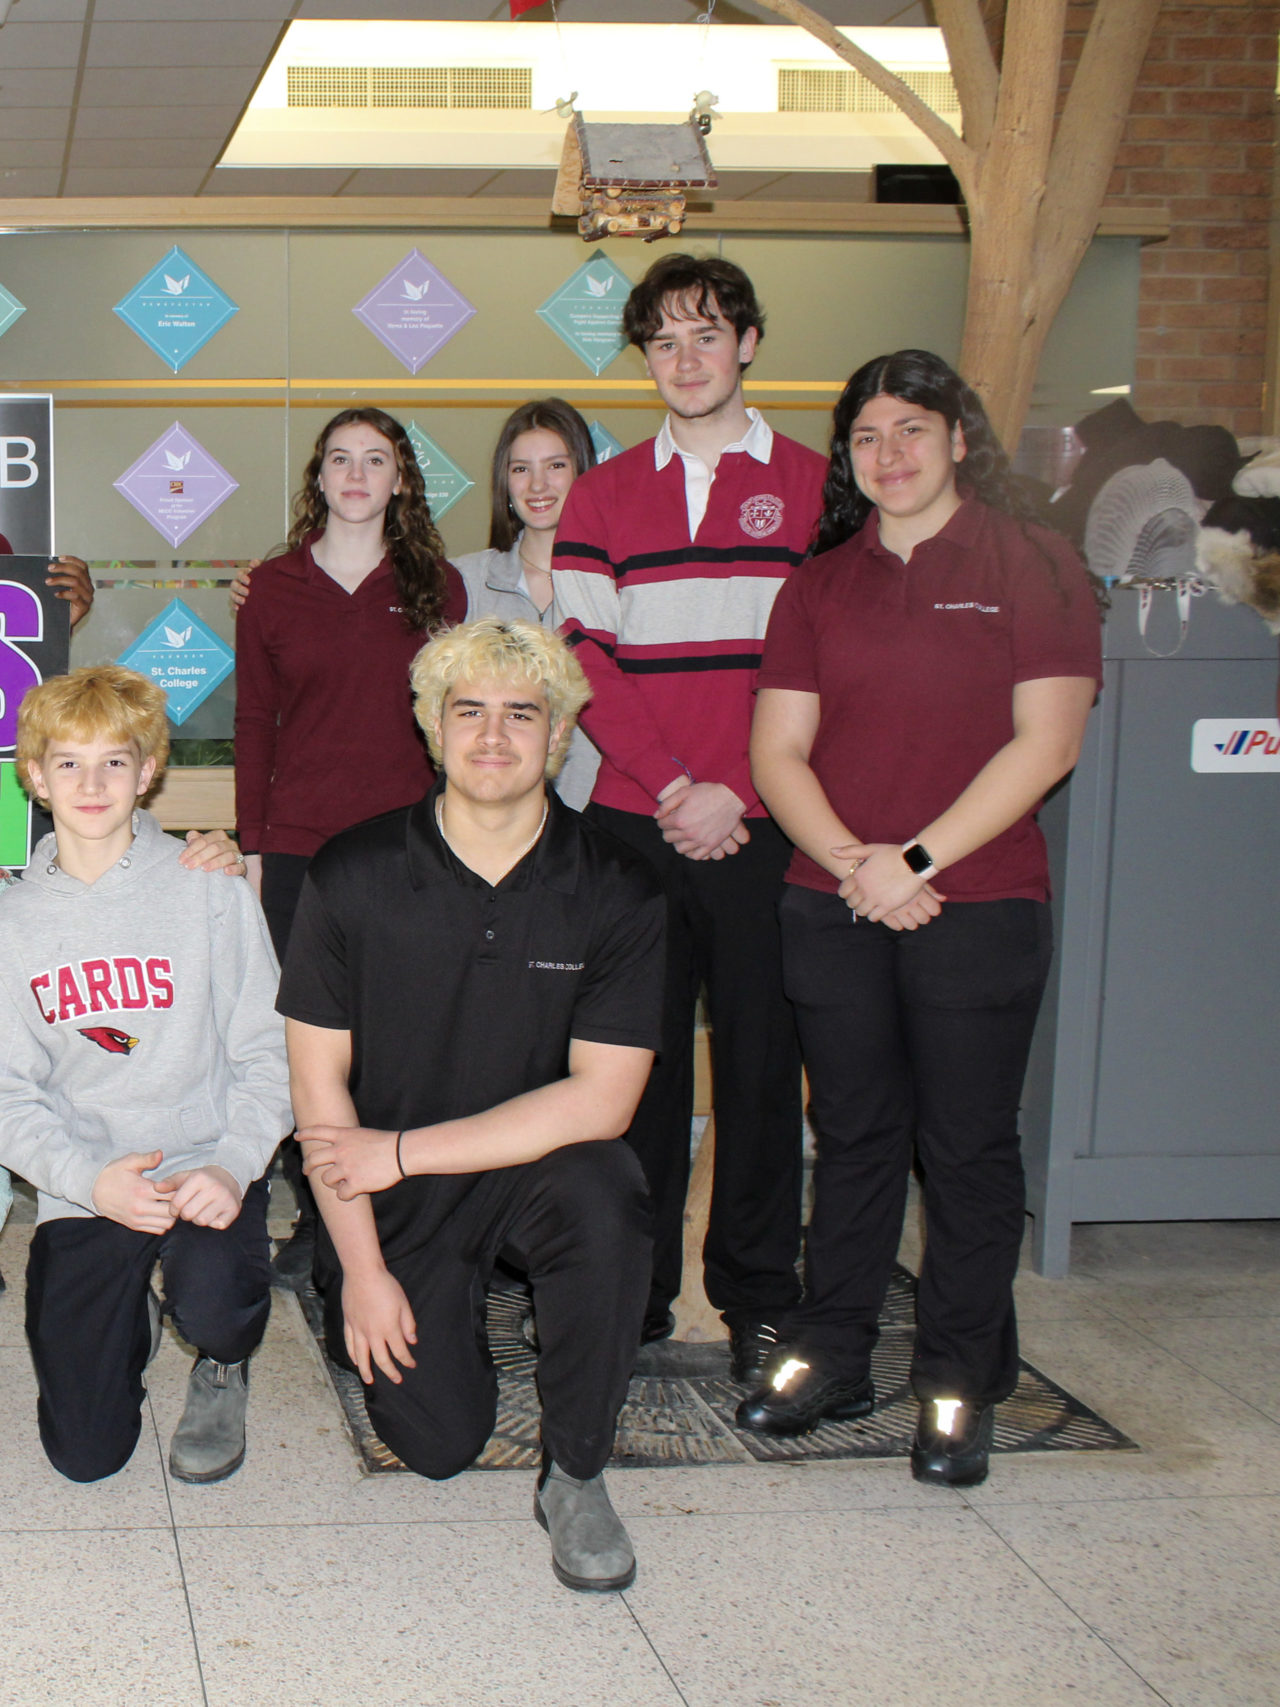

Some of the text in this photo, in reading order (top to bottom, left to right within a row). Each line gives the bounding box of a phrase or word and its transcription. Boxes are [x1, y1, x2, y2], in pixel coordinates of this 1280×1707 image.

[0, 435, 39, 488] B
[151, 666, 207, 676] St. Charles
[160, 679, 198, 689] College
[1243, 730, 1280, 755] Pu
[30, 954, 174, 1025] CARDS
